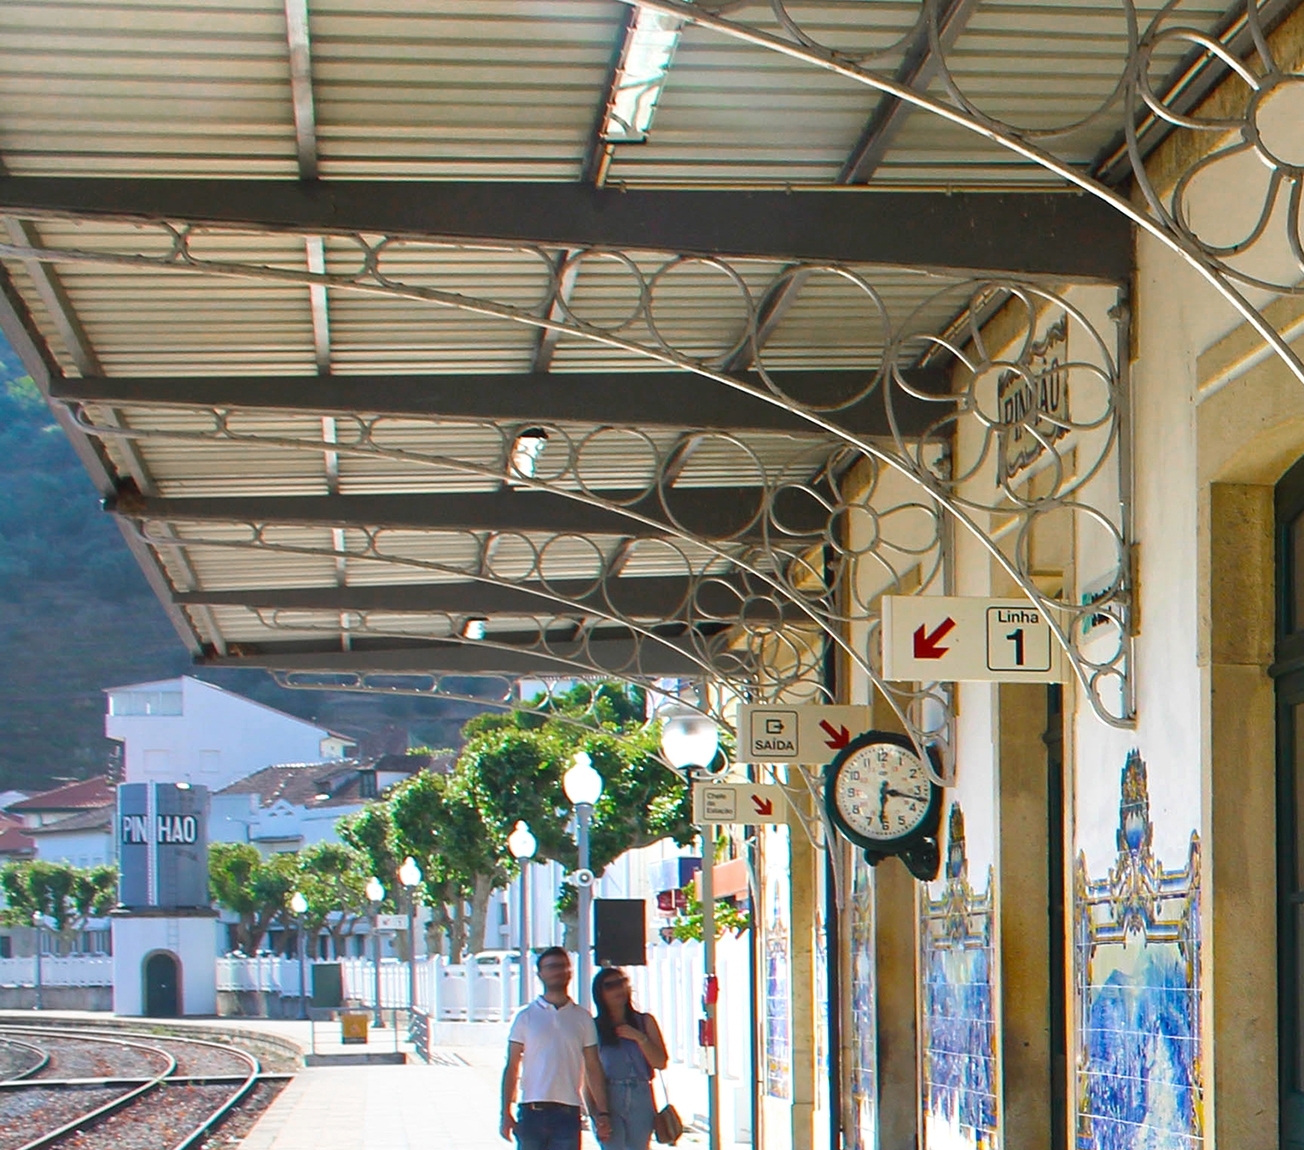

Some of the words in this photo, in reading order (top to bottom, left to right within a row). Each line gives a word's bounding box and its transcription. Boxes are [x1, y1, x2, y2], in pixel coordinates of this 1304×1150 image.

[997, 610, 1039, 623] Linha
[1006, 628, 1024, 666] 1
[755, 737, 794, 751] SAÍDA
[877, 752, 888, 762] 12
[910, 769, 917, 779] 2
[914, 785, 921, 795] 3
[909, 803, 916, 812] 4
[865, 816, 873, 826] 7
[898, 815, 906, 825] 5
[882, 821, 889, 830] 6
